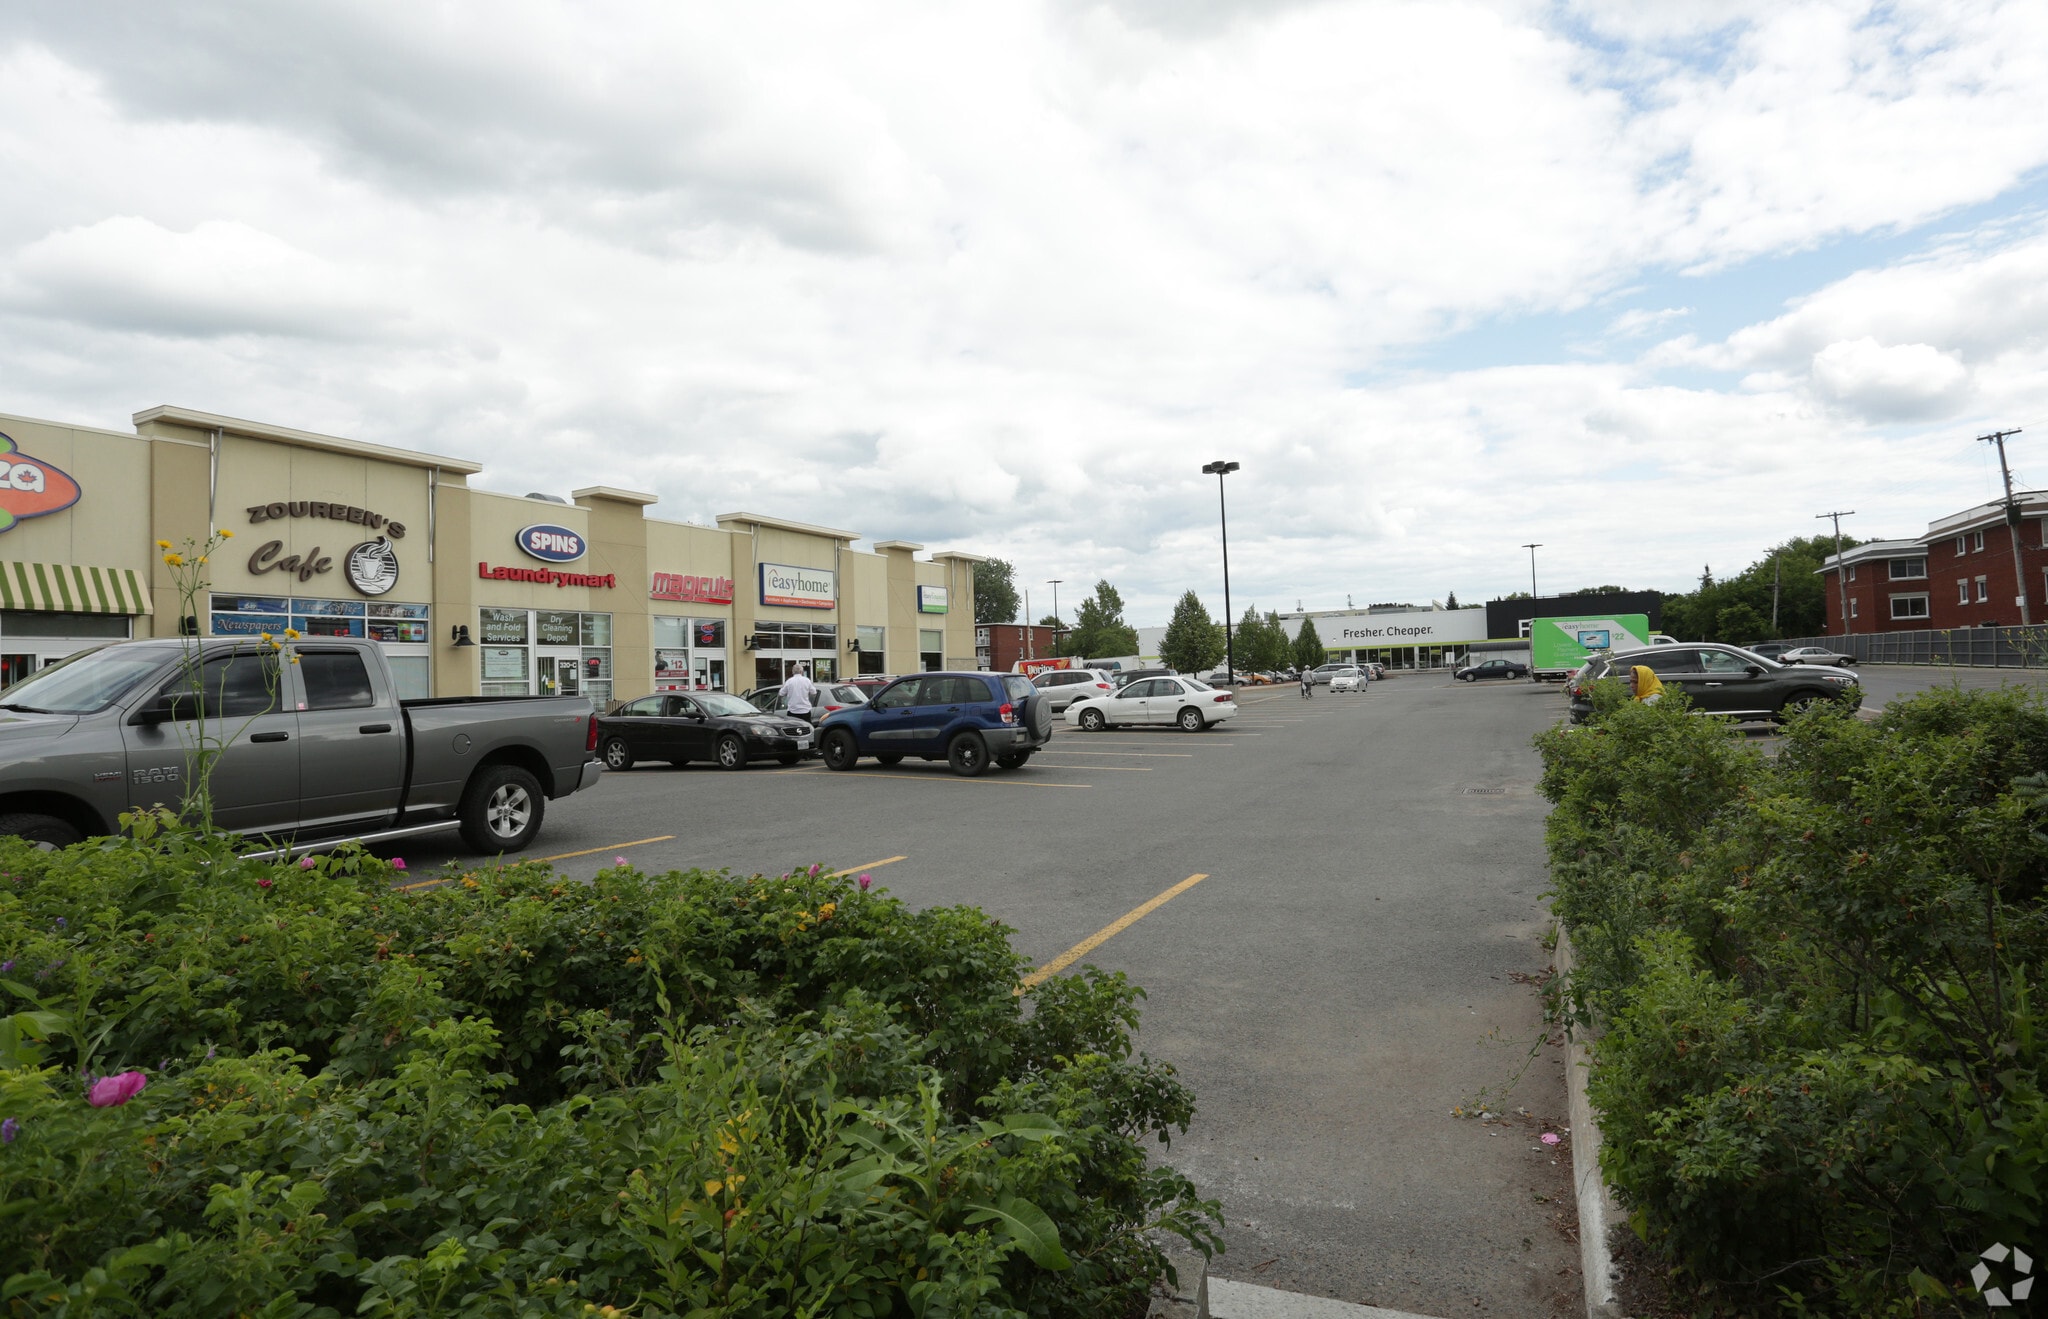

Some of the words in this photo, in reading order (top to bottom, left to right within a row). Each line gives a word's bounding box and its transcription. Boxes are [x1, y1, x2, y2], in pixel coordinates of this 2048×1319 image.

[247, 500, 407, 539] ZOUREEN'S
[530, 531, 578, 555] SPINS
[248, 539, 333, 582] Cafe
[479, 562, 616, 589] Laundrymart
[652, 572, 734, 601] magicuts
[772, 572, 829, 596] easyhome
[492, 612, 515, 622] Wash
[550, 615, 564, 625] Dry
[217, 617, 282, 633] Newspapers
[486, 623, 502, 631] and
[503, 623, 521, 632] Fold
[542, 624, 573, 634] Cleaning
[486, 633, 521, 642] Services
[1343, 627, 1385, 638] Fresher.
[1386, 626, 1434, 637] Cheaper.
[547, 634, 568, 643] Depot
[670, 659, 684, 669] $12
[133, 766, 179, 777] RAM
[133, 773, 179, 785] 1500
